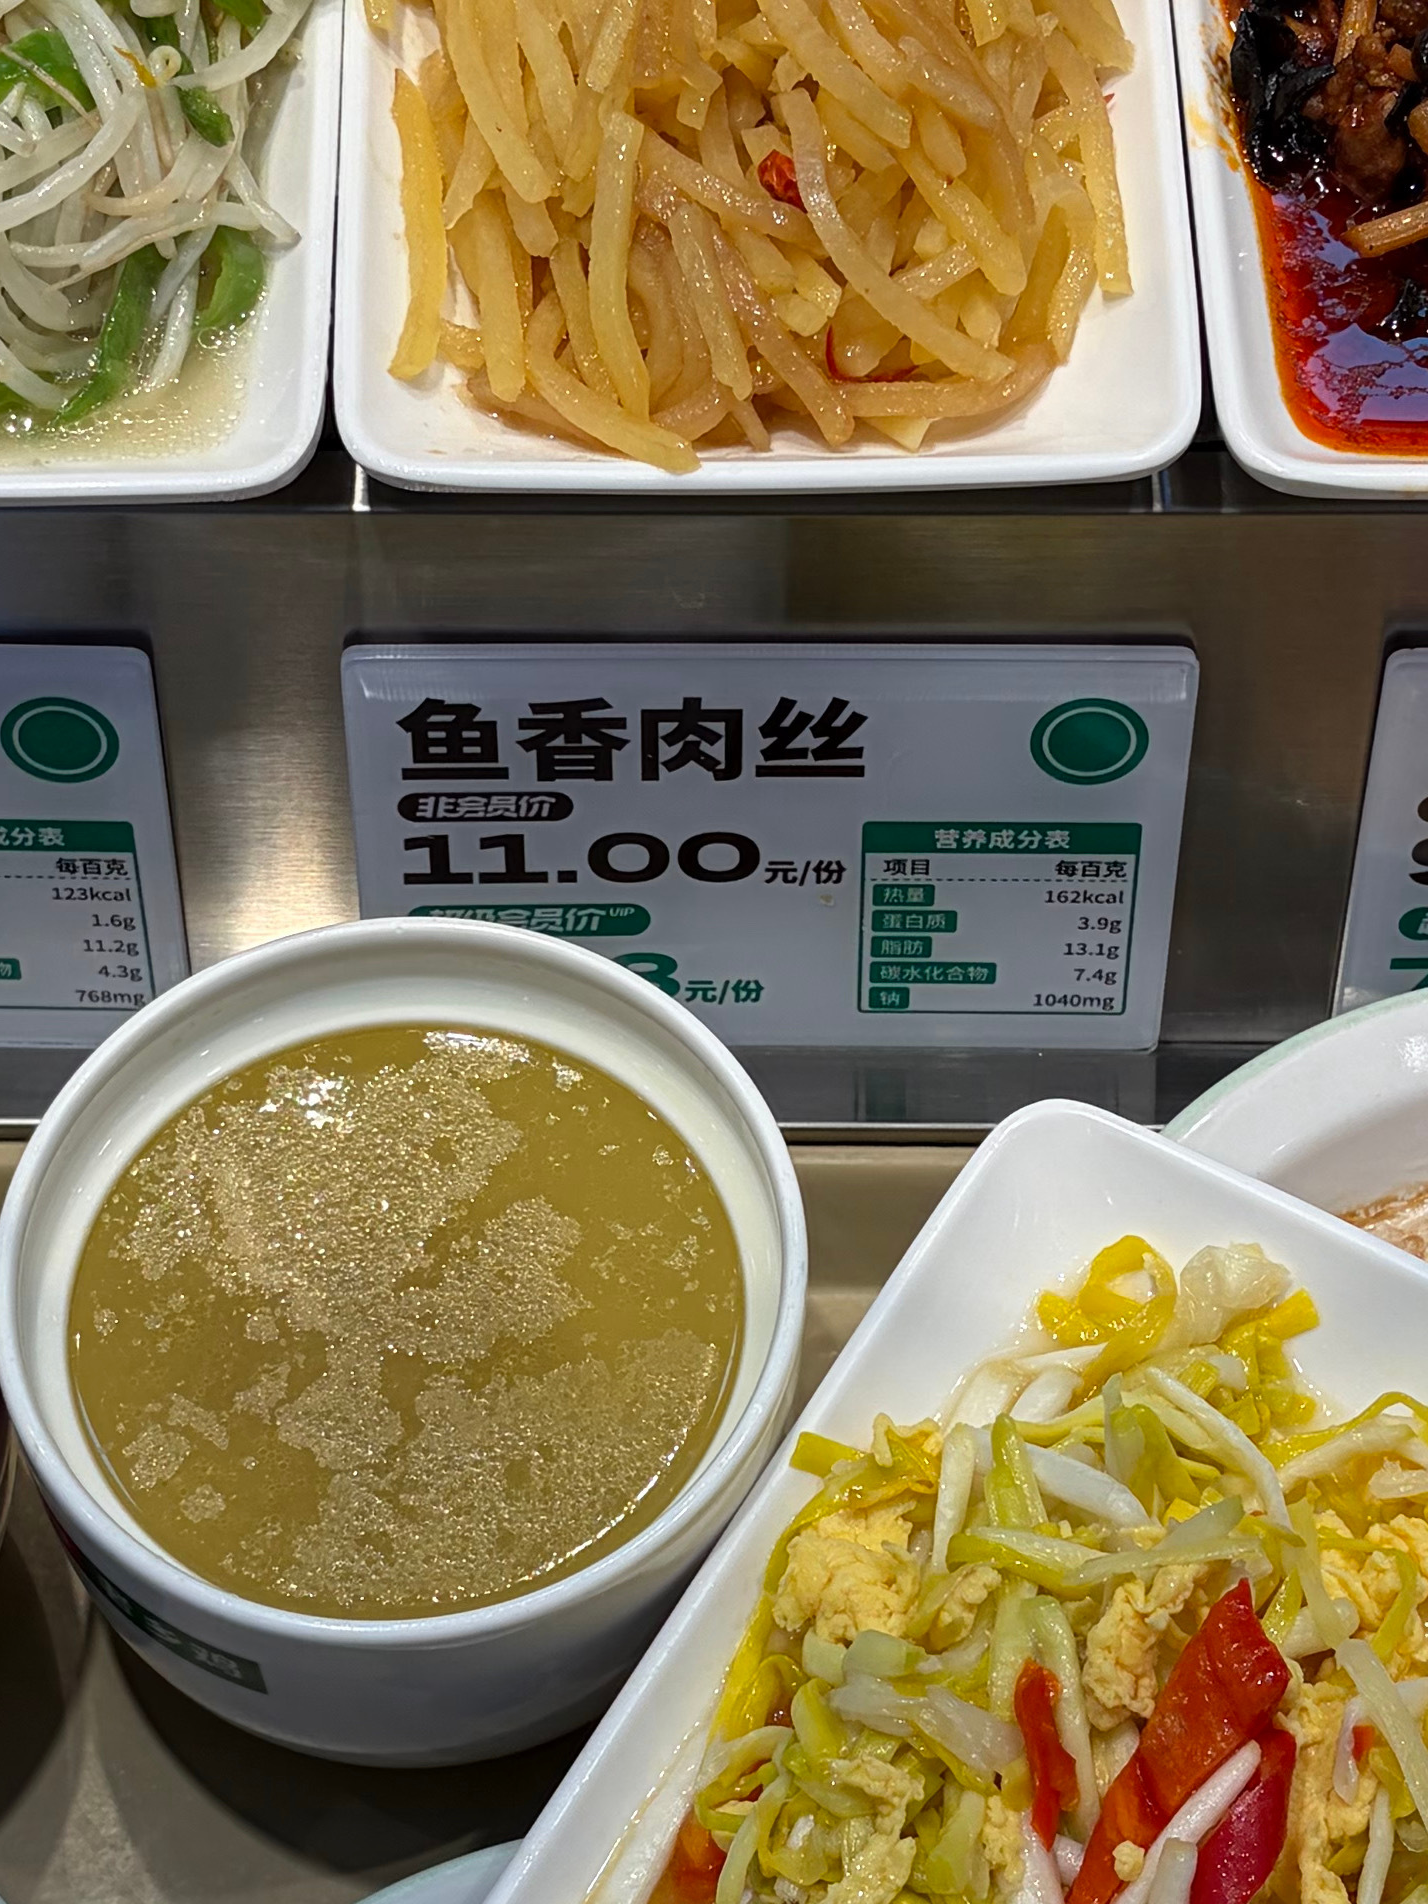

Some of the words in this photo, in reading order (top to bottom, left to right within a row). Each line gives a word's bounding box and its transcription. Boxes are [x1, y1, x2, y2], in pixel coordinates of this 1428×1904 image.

[397, 696, 869, 783] 鱼香肉丝
[416, 796, 555, 820] 非会员价
[935, 829, 1071, 851] 营养成分表
[55, 856, 128, 876] 每百克
[883, 858, 930, 877] 项目
[1055, 859, 1127, 879] 每百克
[51, 885, 131, 903] 123kcal
[1044, 887, 1124, 906] 162kcal
[90, 912, 135, 933] 1.6g
[1078, 914, 1122, 934] 3.9g
[82, 939, 139, 958] 11.2g
[1063, 941, 1119, 960] 13.1g
[97, 964, 143, 984] 4.3g
[1073, 965, 1117, 986] 7.4g
[74, 989, 146, 1008] 768mg
[1033, 992, 1114, 1011] 1040mg
